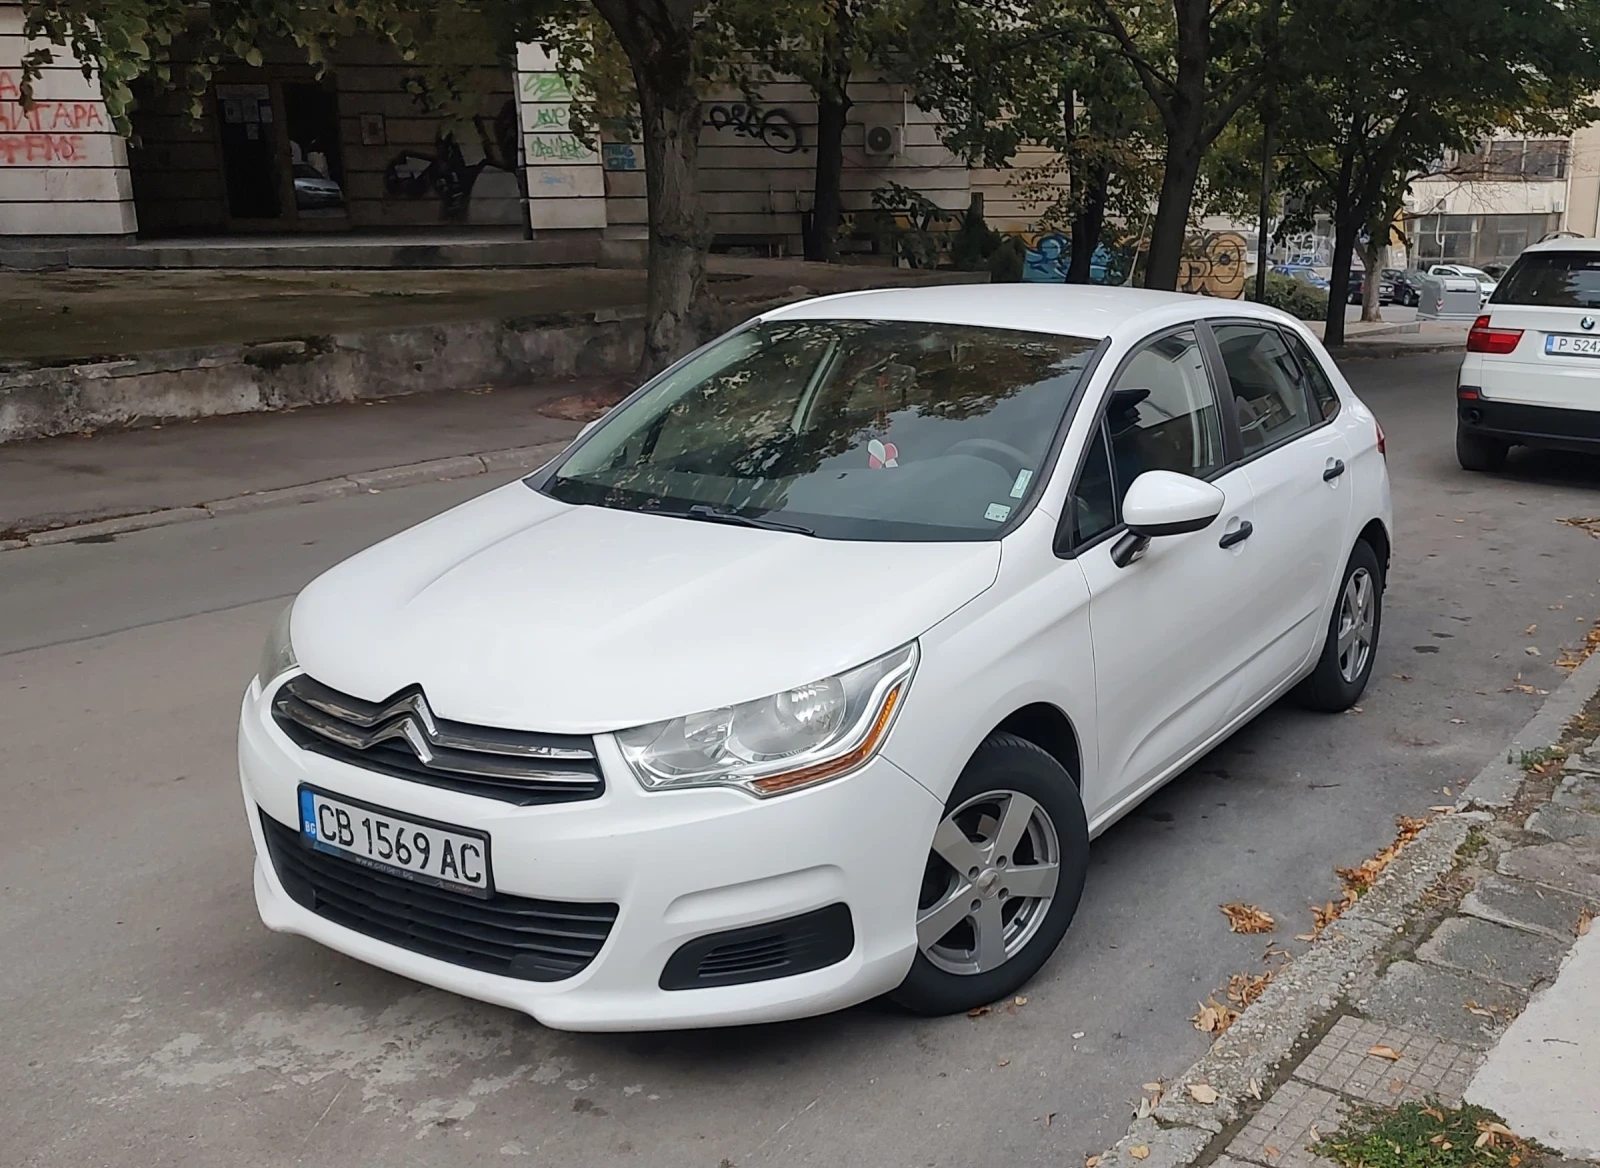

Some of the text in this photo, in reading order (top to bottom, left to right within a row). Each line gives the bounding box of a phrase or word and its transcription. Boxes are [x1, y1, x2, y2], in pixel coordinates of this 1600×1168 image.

[1558, 338, 1568, 350] P
[304, 820, 316, 835] BG
[318, 803, 481, 883] CB 1569 AC
